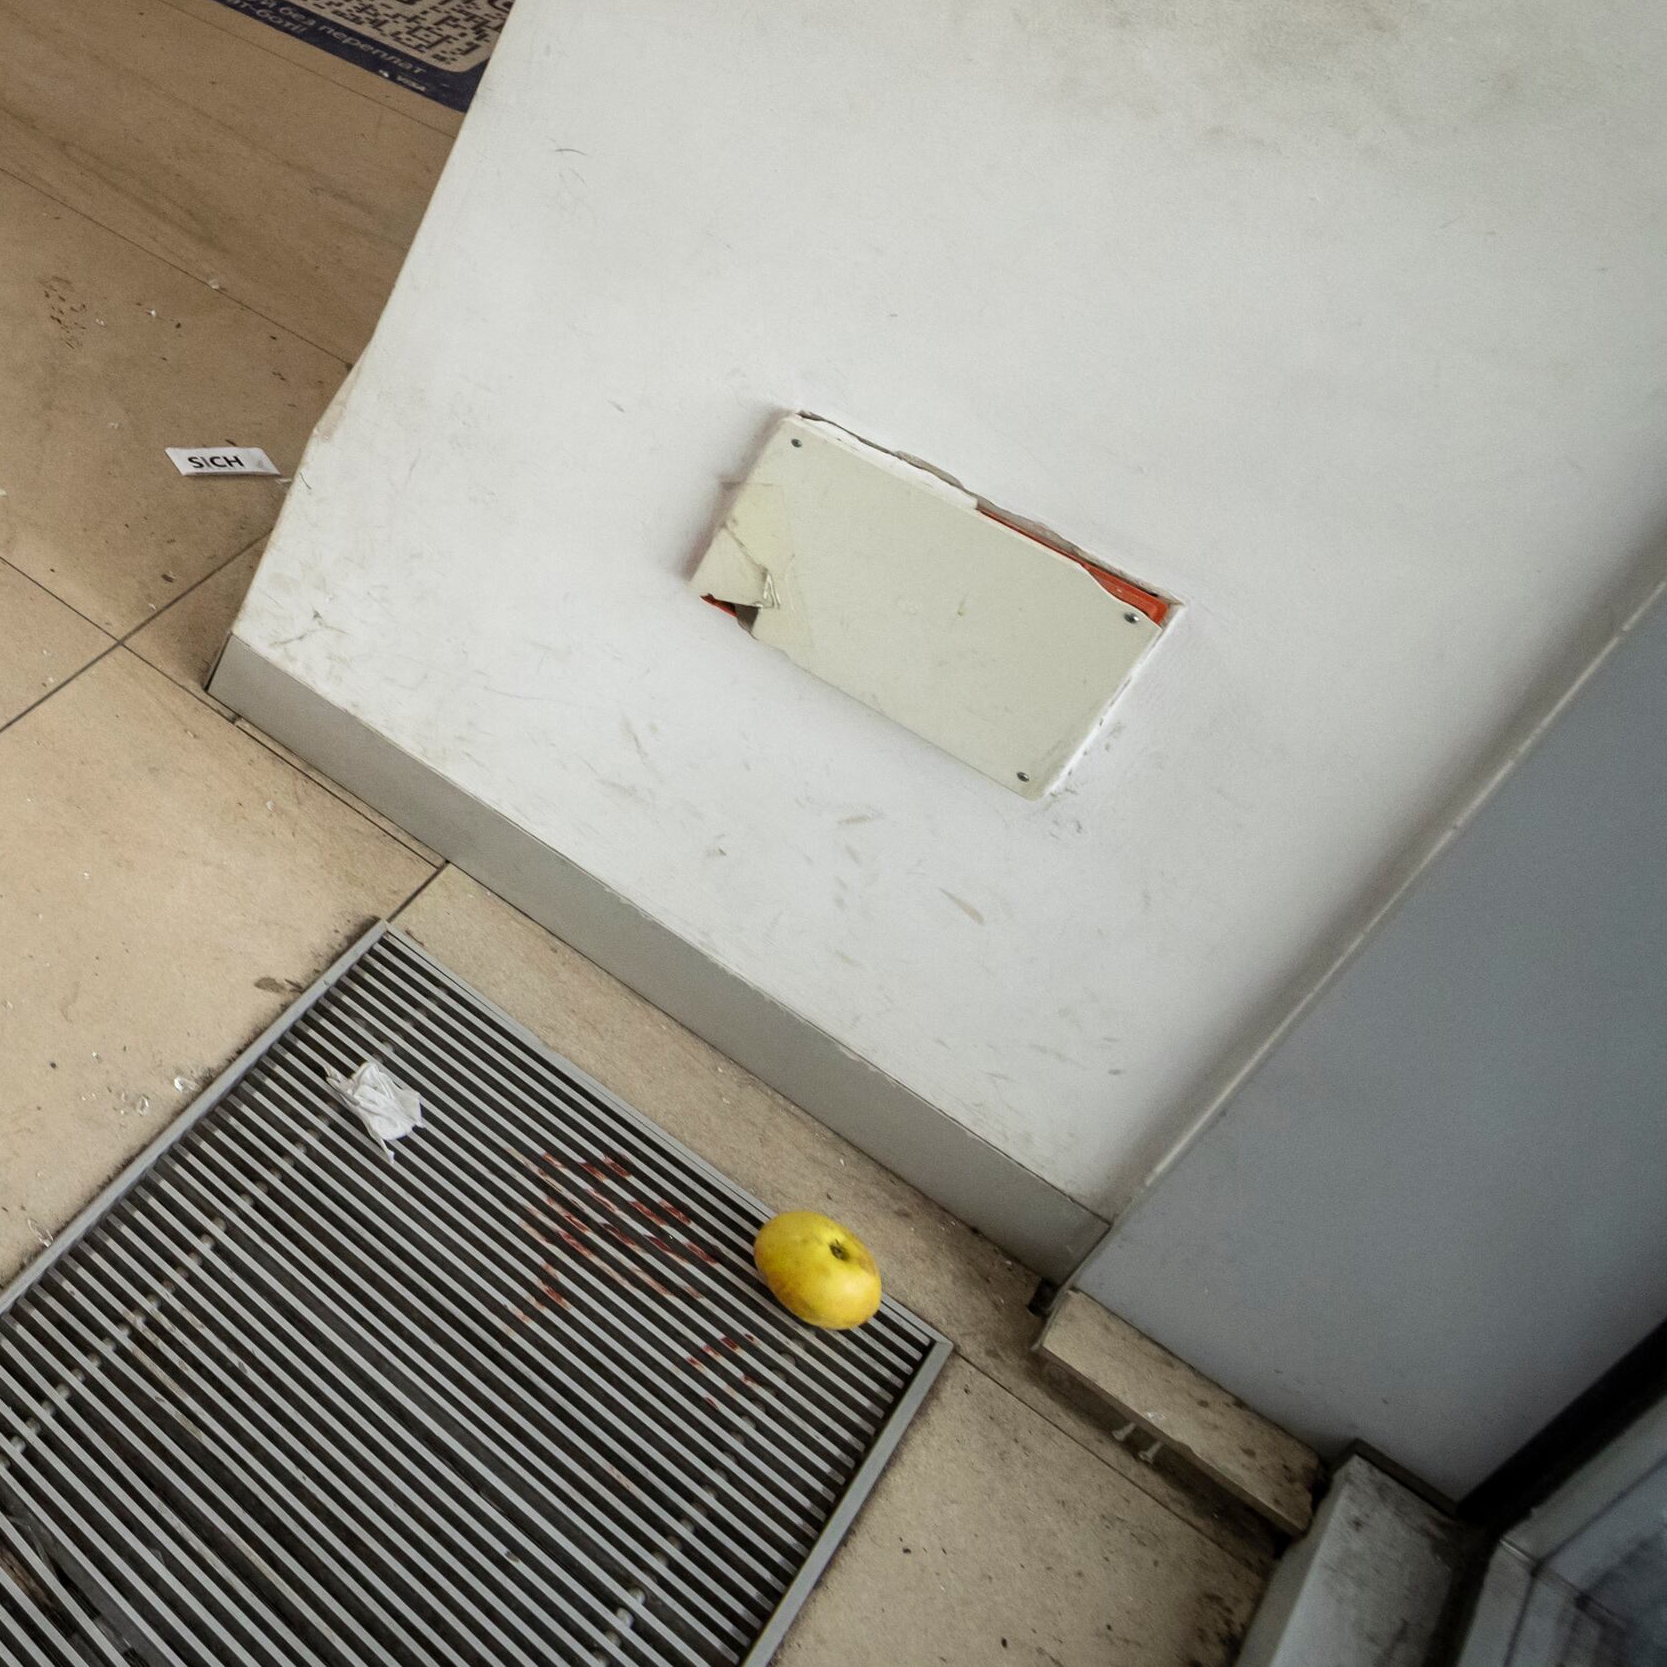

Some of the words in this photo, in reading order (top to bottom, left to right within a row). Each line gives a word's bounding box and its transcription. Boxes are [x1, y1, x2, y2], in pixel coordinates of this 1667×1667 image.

[279, 5, 317, 26] без
[318, 24, 427, 76] переплат
[187, 455, 245, 469] SICH
